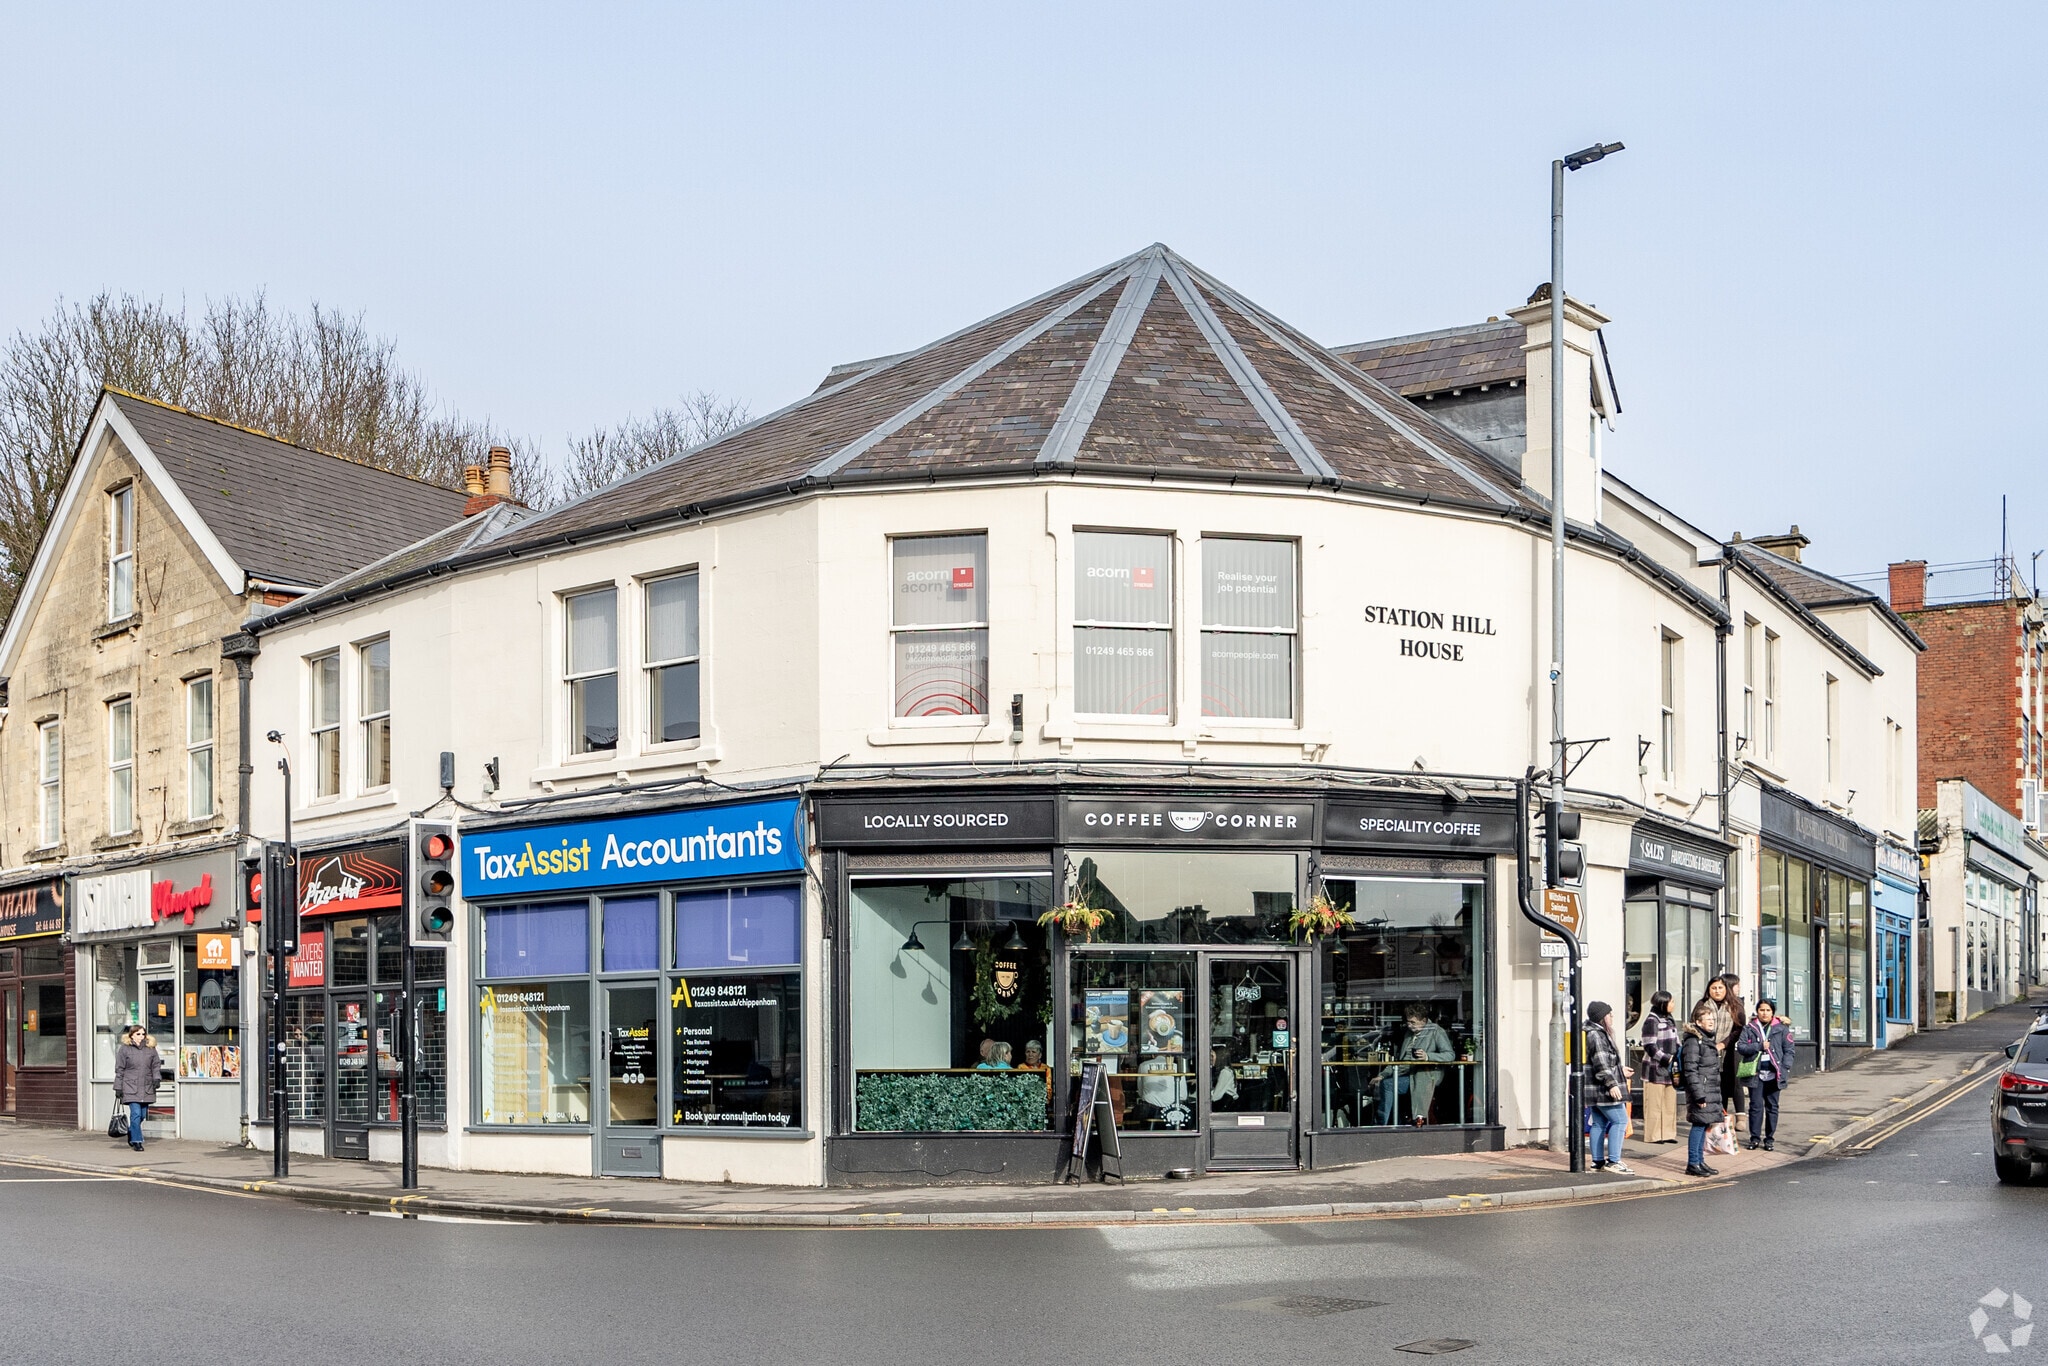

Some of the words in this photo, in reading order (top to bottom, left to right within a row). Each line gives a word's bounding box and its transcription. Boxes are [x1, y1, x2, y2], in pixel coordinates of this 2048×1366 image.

[907, 569, 949, 582] acorn
[1087, 567, 1130, 578] acorn
[1217, 571, 1252, 582] Realise
[1254, 575, 1277, 584] your
[1217, 583, 1233, 593] job
[1235, 584, 1277, 594] potential
[1364, 605, 1444, 630] STATION
[1451, 614, 1497, 636] HILL
[908, 643, 937, 653] 01249
[939, 643, 957, 652] 465
[959, 642, 976, 651] 666
[1086, 646, 1114, 656] 01249
[1116, 647, 1134, 656] 465
[1136, 647, 1154, 657] 666
[1400, 638, 1464, 662] HOUSE
[864, 815, 931, 828] LOCALLY
[933, 813, 1009, 827] SOURCED
[1084, 812, 1162, 827] COFFEE
[1215, 814, 1297, 828] CORNER
[1359, 818, 1433, 834] SPECIALITY
[1433, 821, 1481, 836] COFFEE
[473, 838, 591, 881] TaxAssist
[601, 820, 782, 870] Accountants
[1644, 842, 1665, 861] SALTS
[304, 881, 337, 908] Pizza
[338, 876, 366, 901] Hut
[77, 869, 154, 933] ISTANBUL
[1551, 902, 1569, 912] Swindon
[1560, 914, 1574, 923] Centre
[293, 943, 323, 961] DRIVERS
[1542, 944, 1568, 955] STATIO
[293, 960, 323, 977] WANTED
[994, 961, 1017, 969] COFFEE
[690, 986, 716, 997] 01249
[717, 985, 747, 996] 848121
[993, 981, 1018, 998] CORNER
[273, 992, 279, 1000] 2
[496, 992, 518, 1003] 01249
[519, 992, 545, 1002] 848121
[499, 1004, 570, 1013] taxassist.co.uk/chippenham
[694, 998, 777, 1008] taxassist.co.uk/chippenham
[616, 1027, 650, 1038] TaxAssist
[683, 1026, 713, 1036] Personal
[685, 1111, 703, 1120] Book
[704, 1112, 721, 1122] your
[721, 1111, 767, 1122] consultation
[768, 1112, 791, 1123] today
